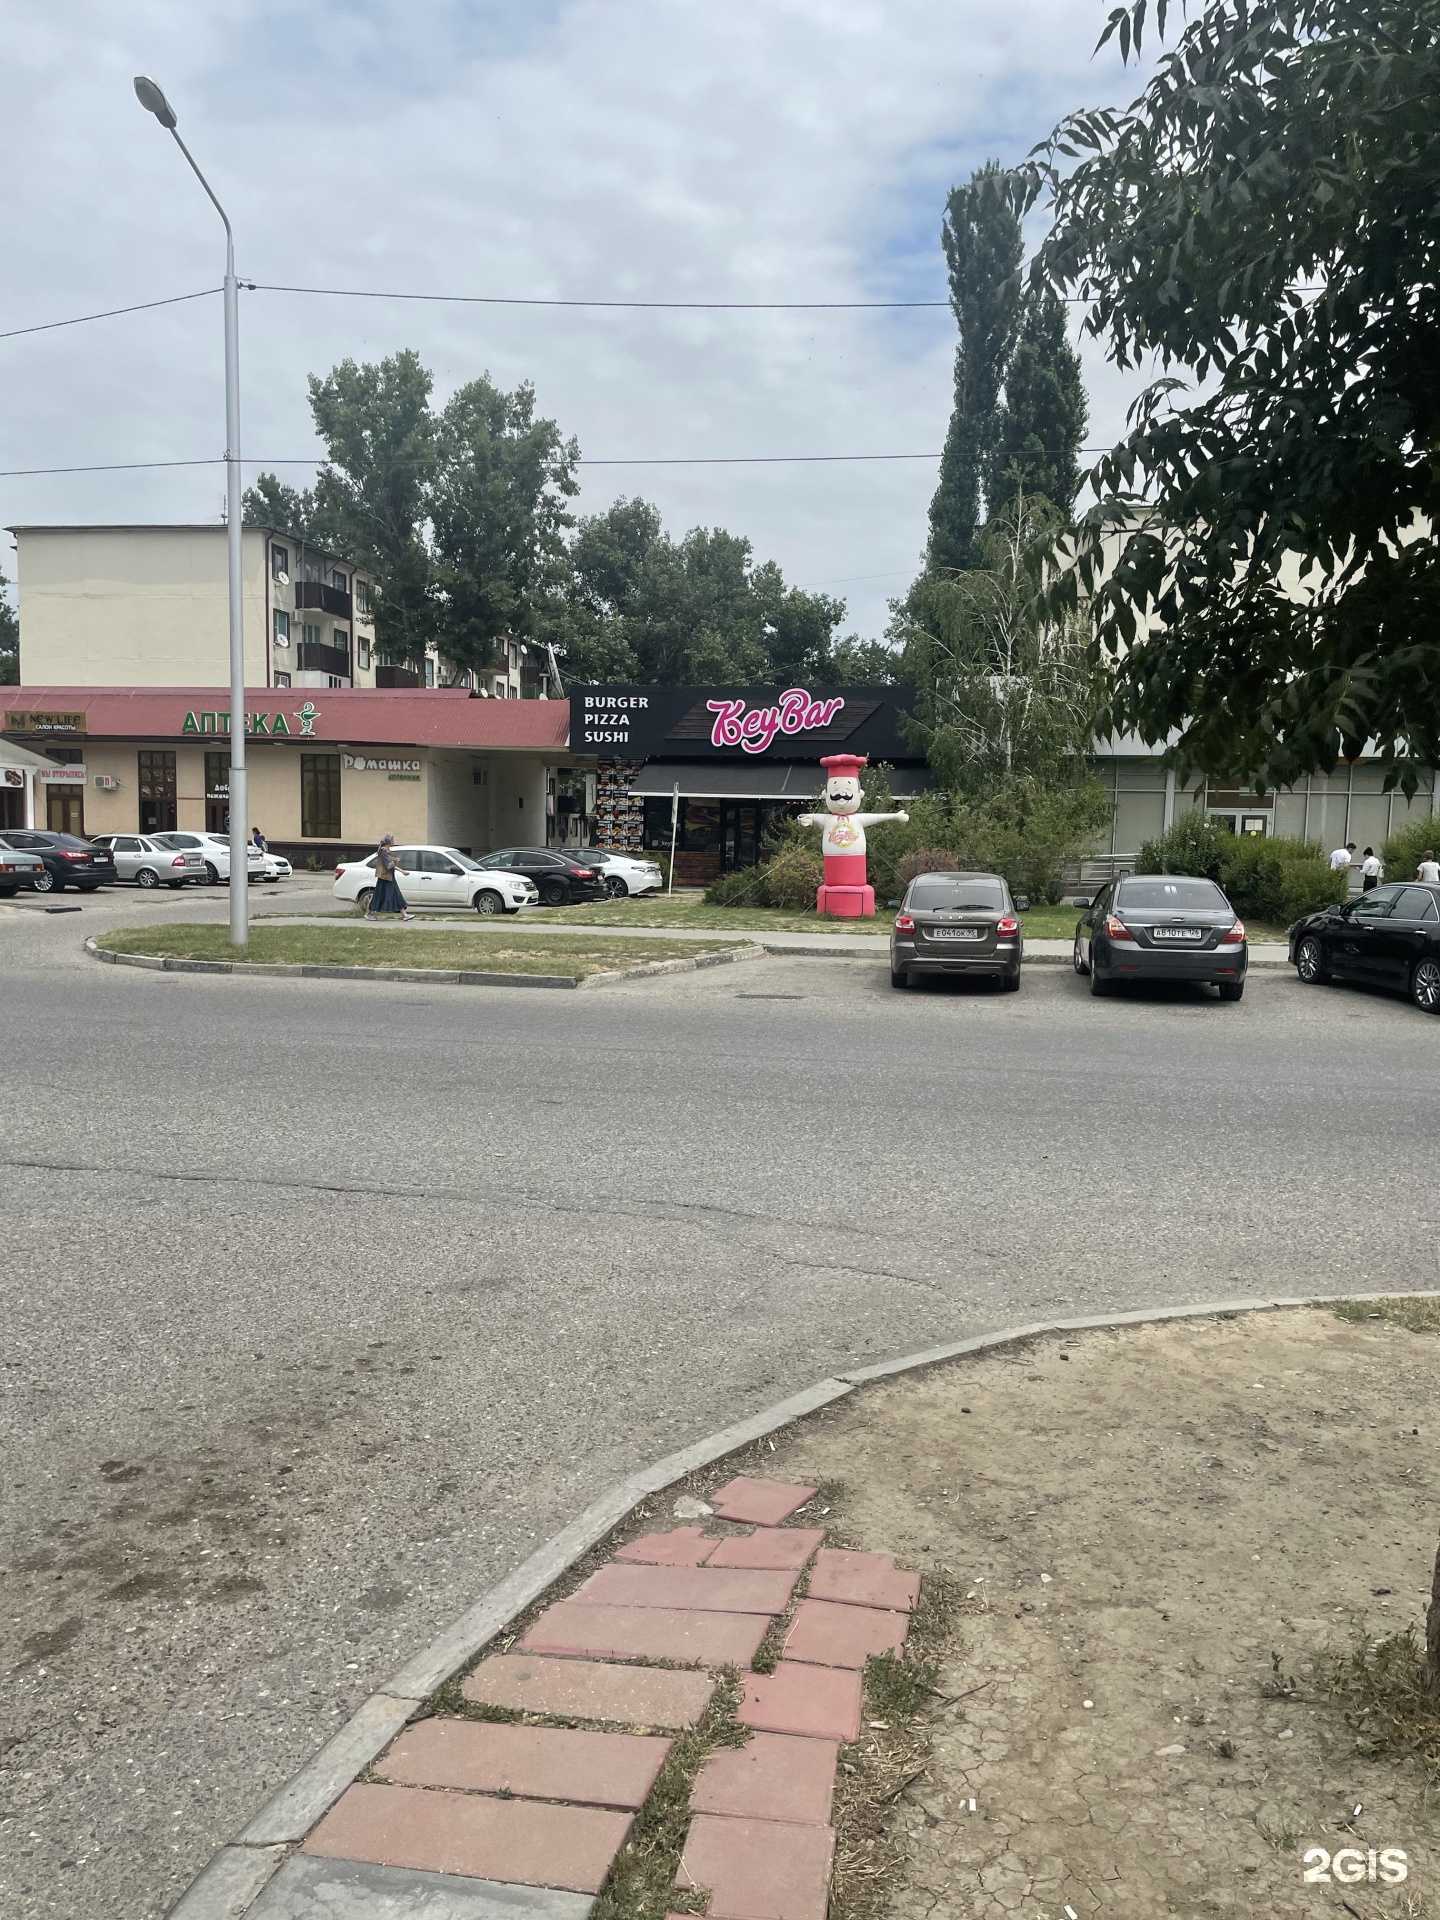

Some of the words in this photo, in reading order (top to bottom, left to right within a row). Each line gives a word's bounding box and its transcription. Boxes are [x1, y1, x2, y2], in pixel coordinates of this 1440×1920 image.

[584, 696, 649, 708] BURGER
[584, 713, 630, 725] PIZZA
[584, 731, 629, 743] SUSHI
